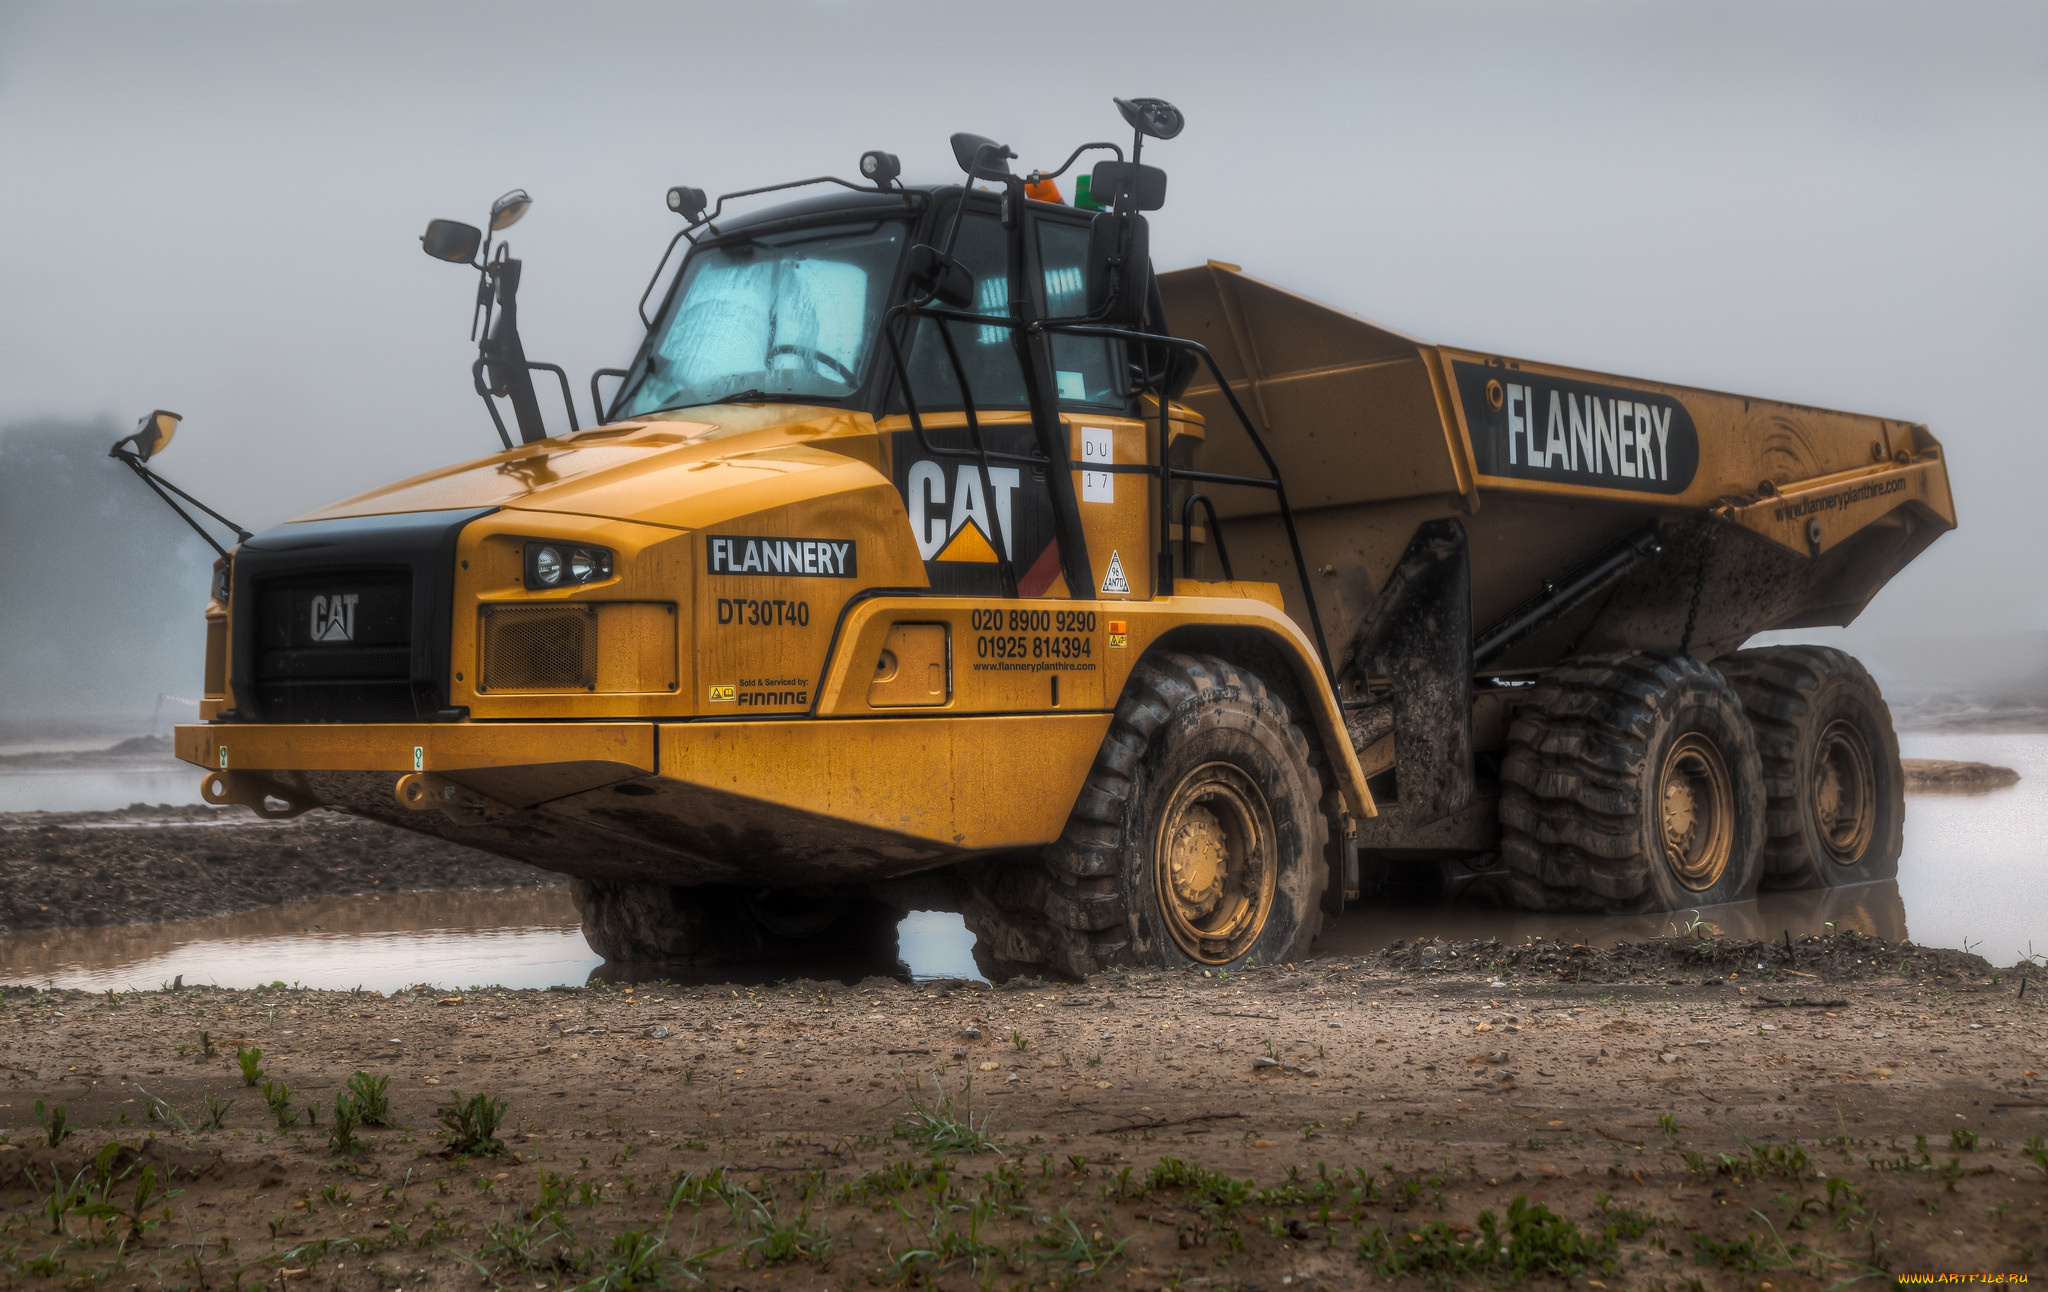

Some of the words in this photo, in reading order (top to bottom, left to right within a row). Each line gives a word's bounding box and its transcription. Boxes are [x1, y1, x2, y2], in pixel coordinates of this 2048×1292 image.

[1506, 383, 1672, 481] FLANNERY
[908, 460, 1020, 562] CAT
[1775, 478, 1907, 522] www.flanneryplanthire.com
[712, 539, 849, 575] FLANNERY
[311, 594, 359, 641] CAT
[717, 598, 810, 627] DT30T40
[971, 608, 1003, 631] 020
[1009, 609, 1051, 632] 8900
[1056, 610, 1096, 632] 9290
[977, 636, 1028, 658] 01925
[1032, 636, 1091, 658] 814394
[739, 679, 756, 687] Sold
[765, 678, 796, 686] Serviced
[797, 678, 809, 687] by:
[973, 661, 1096, 672] www.flanneryplanthire.com
